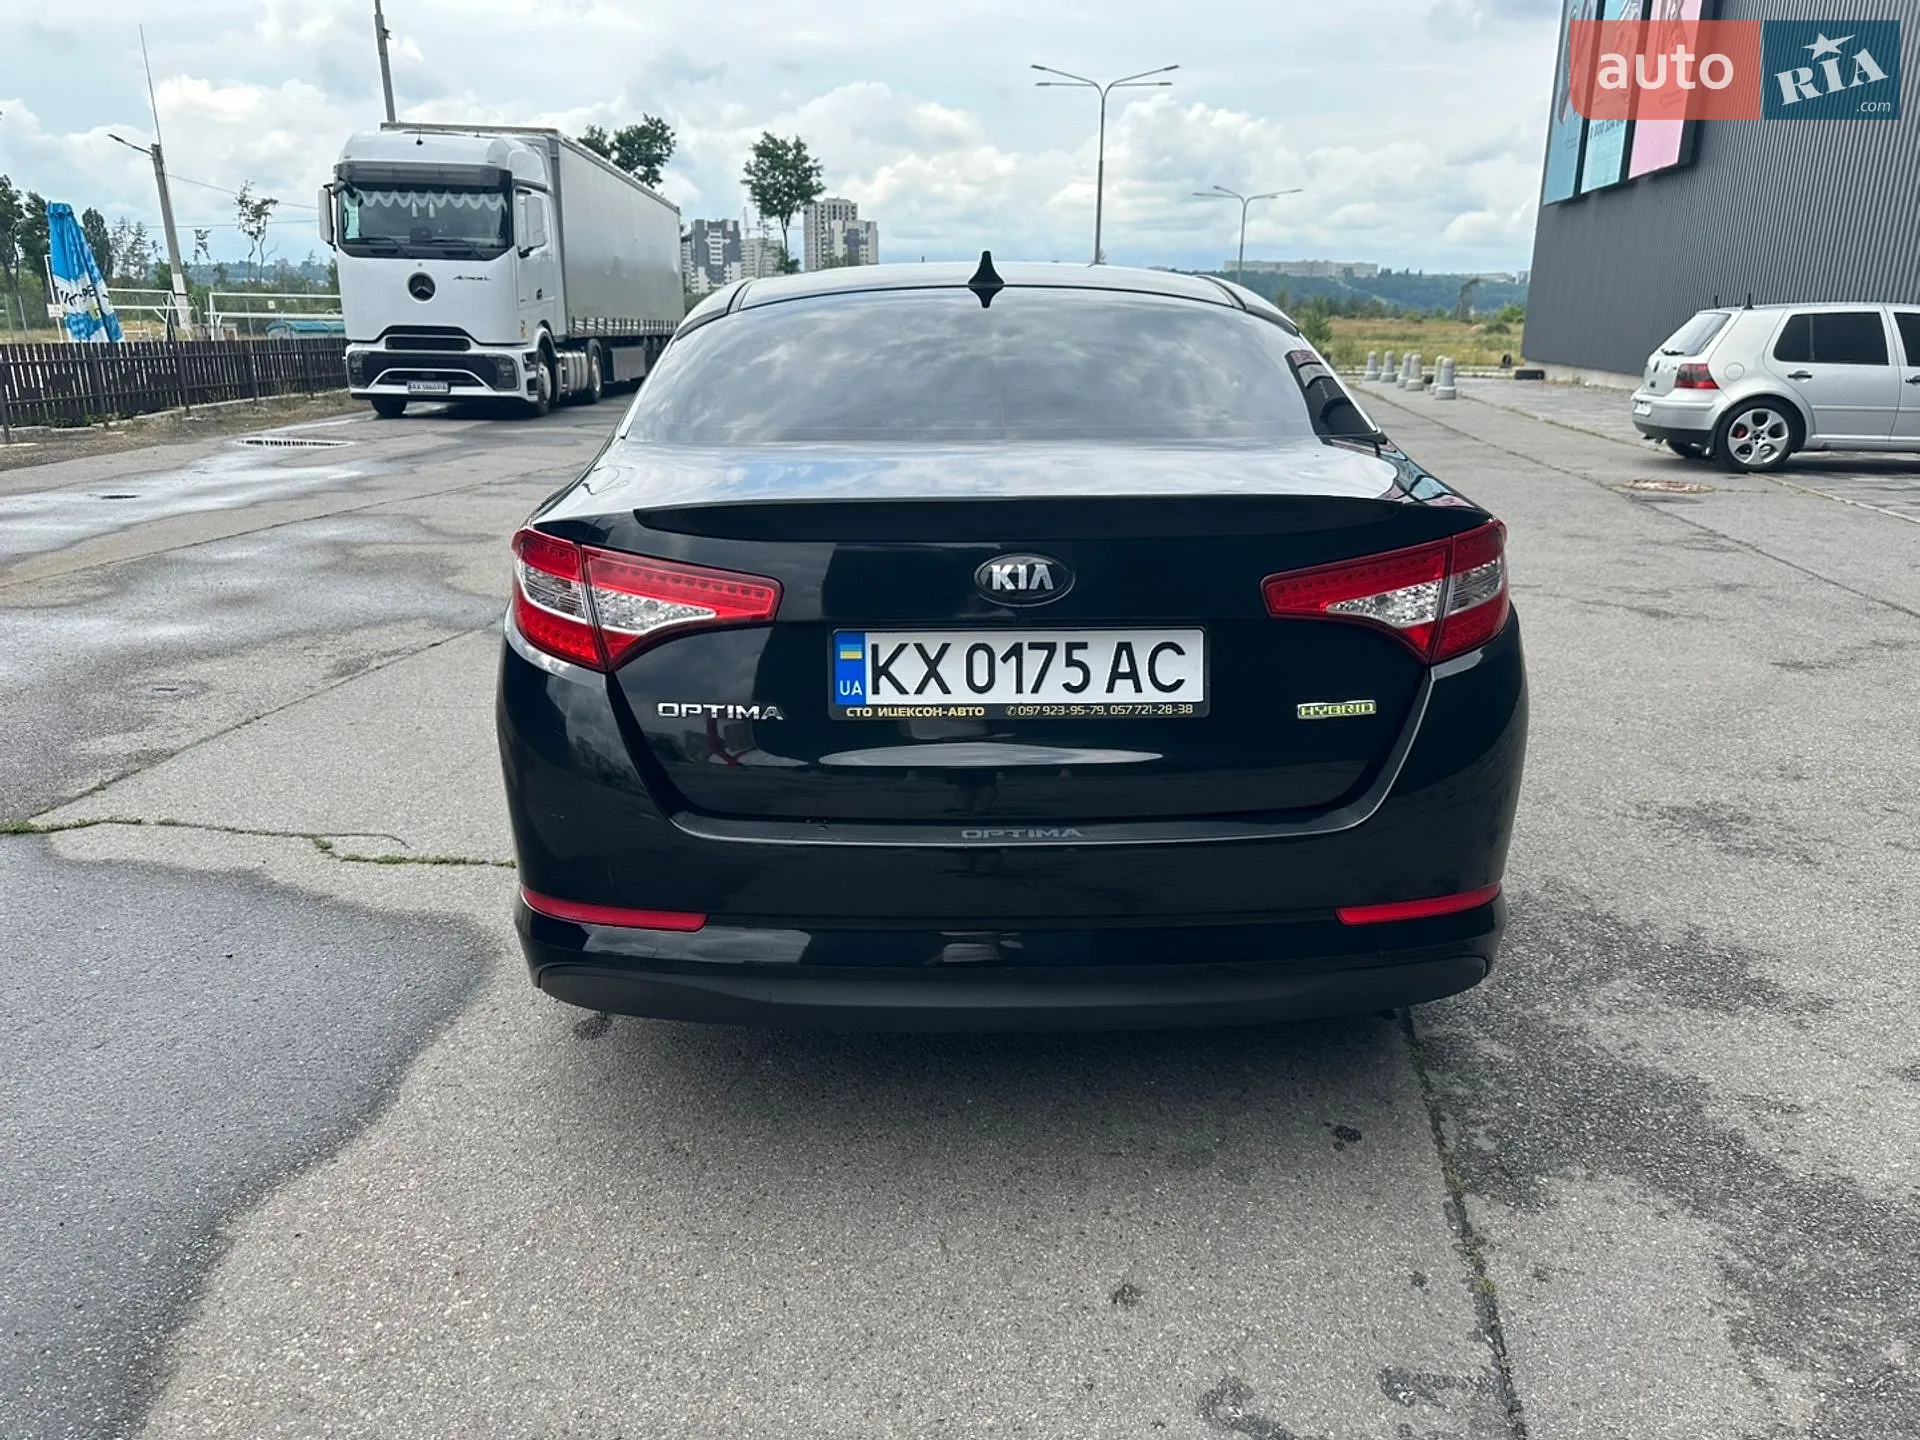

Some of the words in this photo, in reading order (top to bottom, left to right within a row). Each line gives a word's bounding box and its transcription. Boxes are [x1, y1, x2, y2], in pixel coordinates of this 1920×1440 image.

[990, 564, 1054, 590] KIA
[839, 680, 863, 696] UA
[871, 642, 952, 695] KX
[965, 641, 1091, 695] 0175
[1105, 641, 1186, 693] AC
[657, 702, 784, 720] OPTIMA
[846, 706, 873, 717] СТО
[877, 706, 985, 718] ИЦЕКСОН-АВТО
[1301, 702, 1374, 717] HYBRID
[961, 828, 1084, 839] OPTIMA
